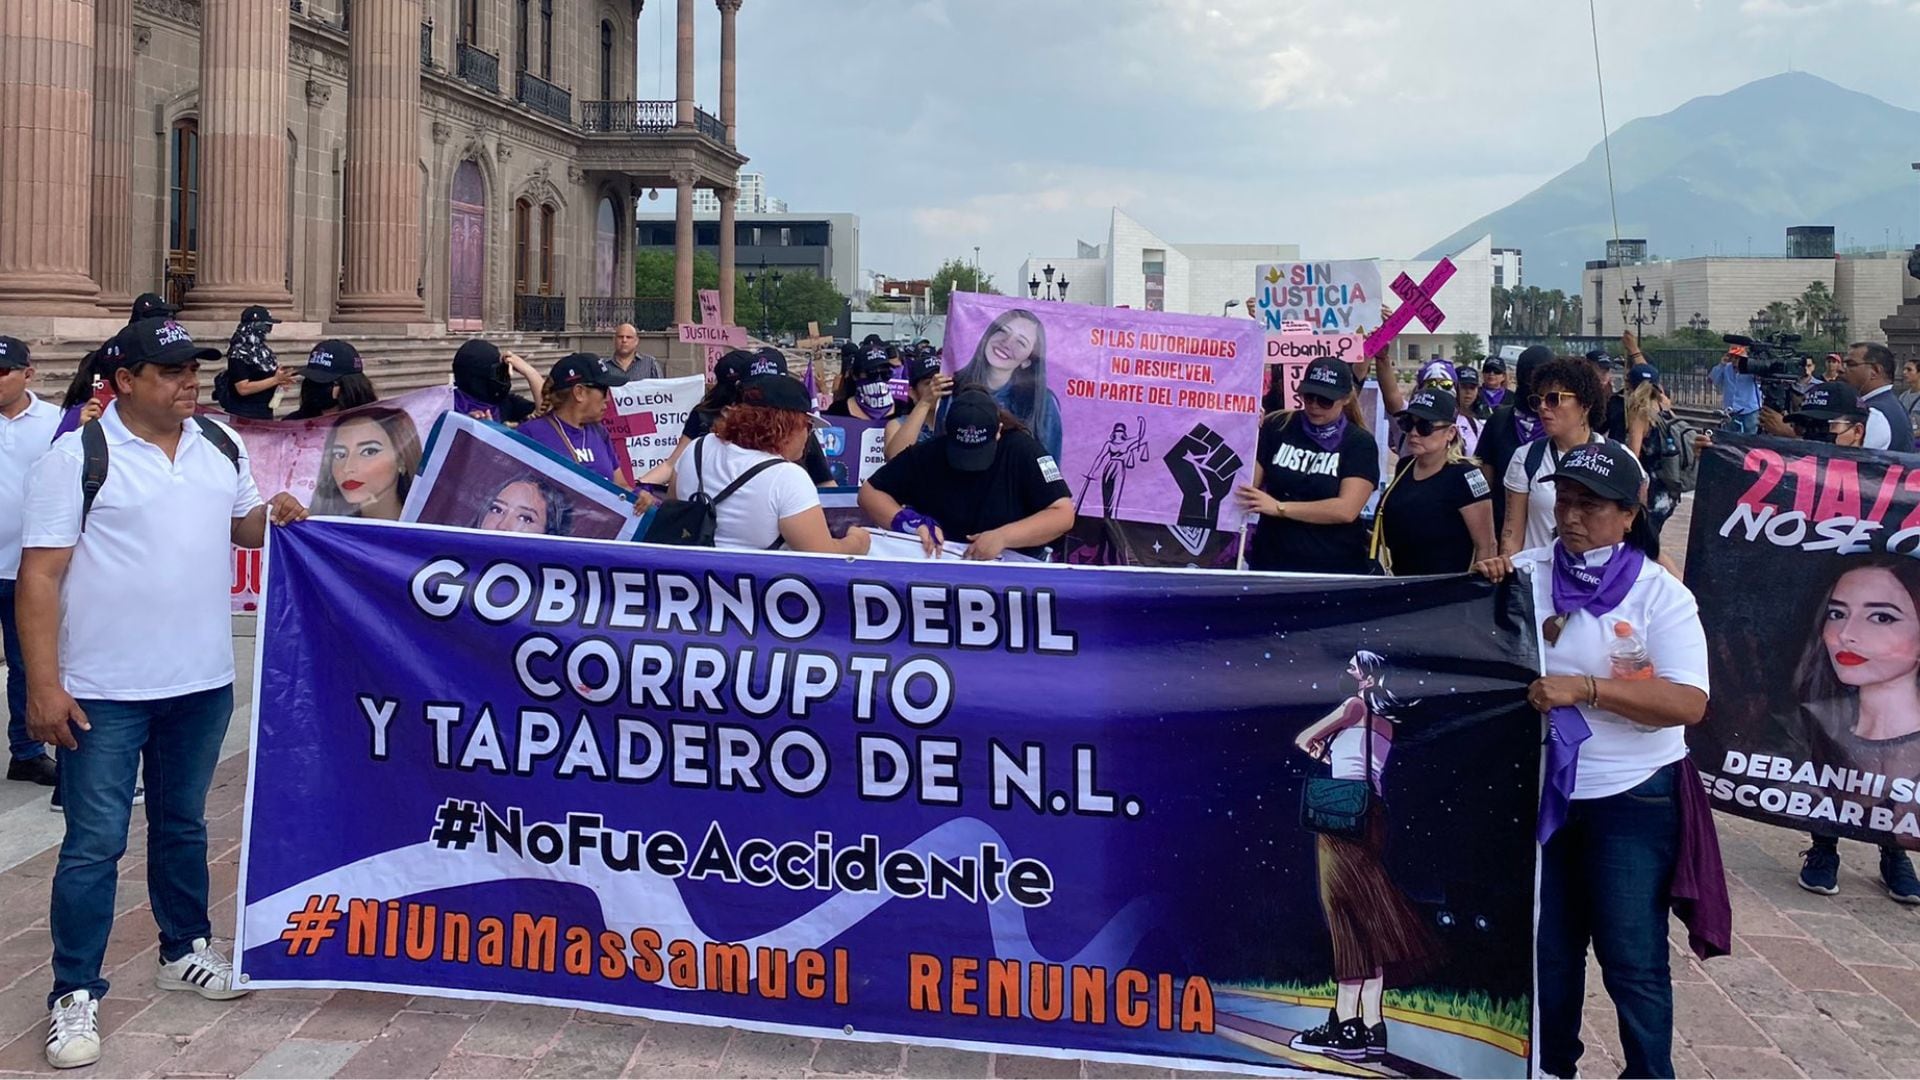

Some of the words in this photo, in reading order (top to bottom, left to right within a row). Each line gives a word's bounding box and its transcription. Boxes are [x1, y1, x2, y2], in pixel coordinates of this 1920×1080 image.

[1290, 263, 1331, 285] SIN
[1259, 282, 1366, 308] JUSTICIA
[1391, 276, 1443, 331] JUSTICIA
[683, 326, 729, 341] JUSTICIA
[1304, 306, 1353, 328] HAY
[1090, 328, 1105, 346] SI
[1109, 329, 1135, 348] LAS
[1140, 332, 1236, 358] AUTORIDADES
[1267, 340, 1331, 358] Debanhi
[1111, 356, 1130, 375] NO
[1134, 360, 1215, 385] RESUELVEN,
[637, 391, 673, 406] LEÓN
[1067, 378, 1095, 398] SON
[1100, 382, 1144, 404] PARTE
[1149, 387, 1173, 407] DEL
[1178, 389, 1256, 414] PROBLEMA
[1272, 442, 1340, 477] JUSTICIA
[1719, 502, 1806, 547] NO
[411, 558, 821, 639] GOBIERNO
[852, 583, 1075, 651] DEBIL
[515, 636, 951, 724] CORRUPTO
[360, 697, 397, 757] Y
[426, 705, 827, 794] TAPADERO
[860, 736, 959, 802] DE
[992, 742, 1141, 817] N.L.
[1722, 750, 1886, 798] DEBANHI
[1889, 777, 1920, 807] S
[908, 952, 1216, 1034] RENUNCIA
